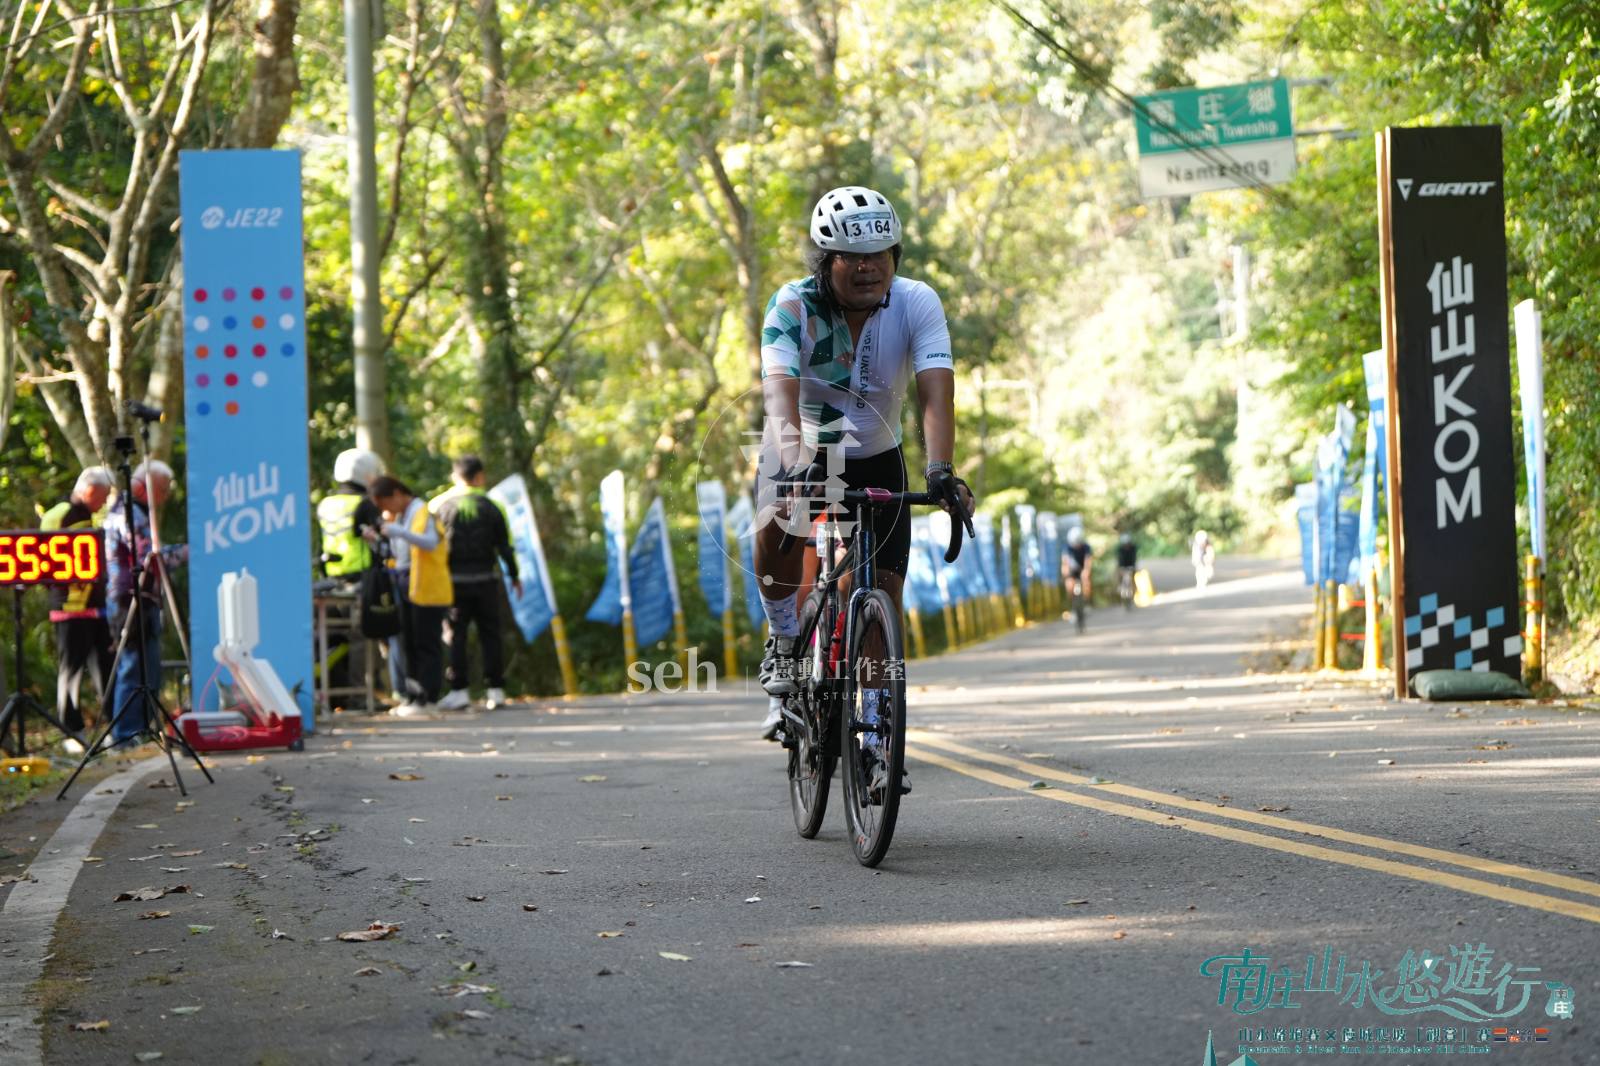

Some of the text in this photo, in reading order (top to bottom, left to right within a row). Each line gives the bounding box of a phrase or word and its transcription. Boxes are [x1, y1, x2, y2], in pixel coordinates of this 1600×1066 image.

[1221, 119, 1278, 137] Township
[1418, 181, 1496, 196] GIANT
[225, 207, 283, 228] JE22
[1426, 256, 1482, 529] 仙山 KOM
[212, 461, 279, 513] 仙山
[204, 492, 297, 553] KOM
